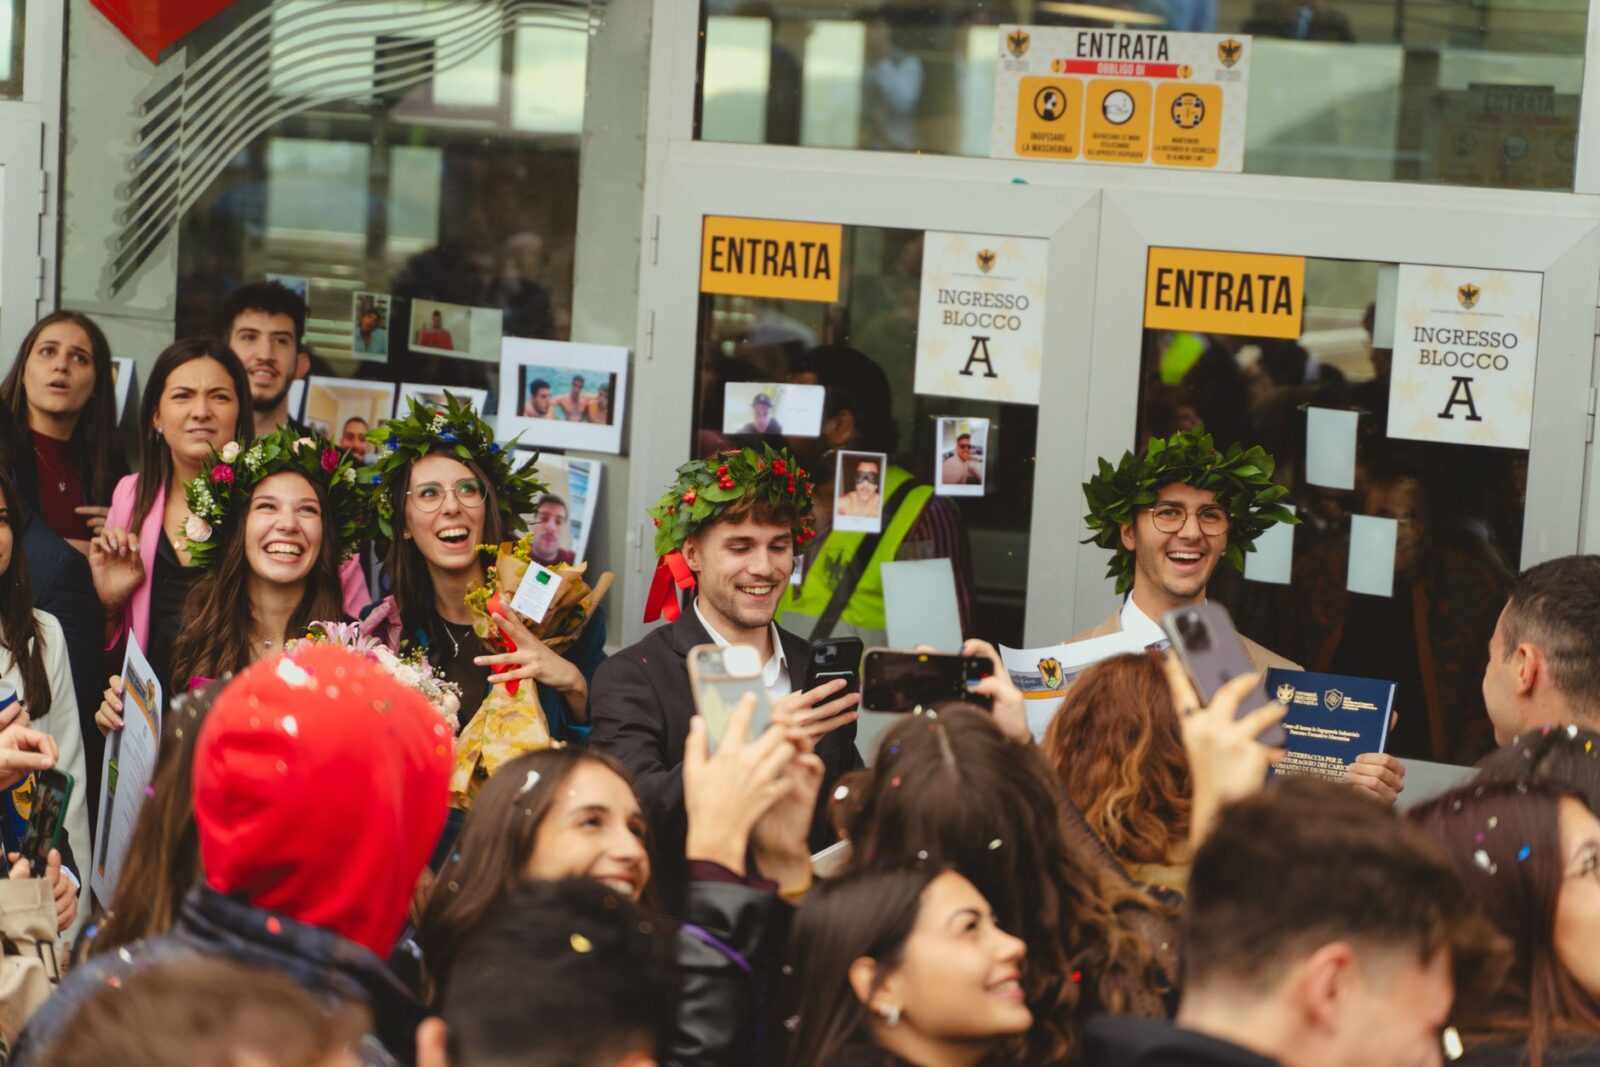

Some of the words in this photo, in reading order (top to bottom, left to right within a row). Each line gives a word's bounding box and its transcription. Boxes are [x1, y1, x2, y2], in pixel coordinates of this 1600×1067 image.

[1077, 31, 1169, 61] ENTRATA
[1097, 62, 1134, 75] OBBLIGO
[1135, 63, 1146, 76] DI
[1022, 143, 1030, 152] LA
[1031, 144, 1073, 154] MASCHERINA
[709, 236, 832, 280] ENTRATA
[937, 288, 1030, 311] INGRESSO
[1155, 268, 1293, 315] ENTRATA
[942, 311, 1021, 331] BLOCCO
[1413, 326, 1519, 350] INGRESSO
[959, 335, 998, 378] A
[1419, 350, 1509, 371] BLOCCO
[1437, 376, 1482, 422] A
